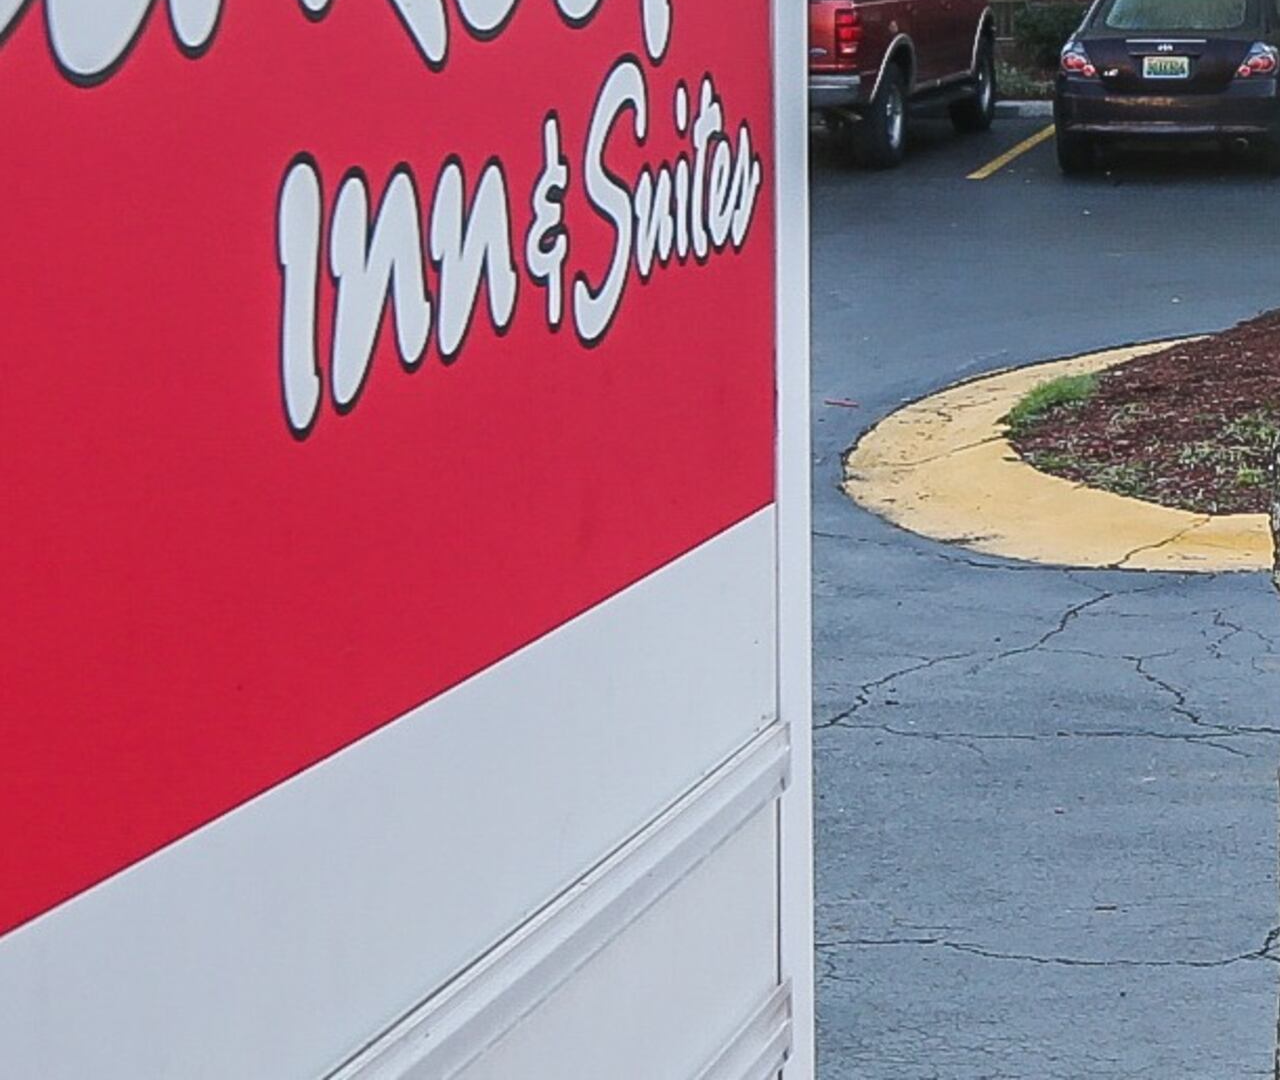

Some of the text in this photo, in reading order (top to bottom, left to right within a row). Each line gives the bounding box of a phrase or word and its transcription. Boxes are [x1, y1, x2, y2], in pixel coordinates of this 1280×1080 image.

[276, 54, 762, 438] Inn & Suites
